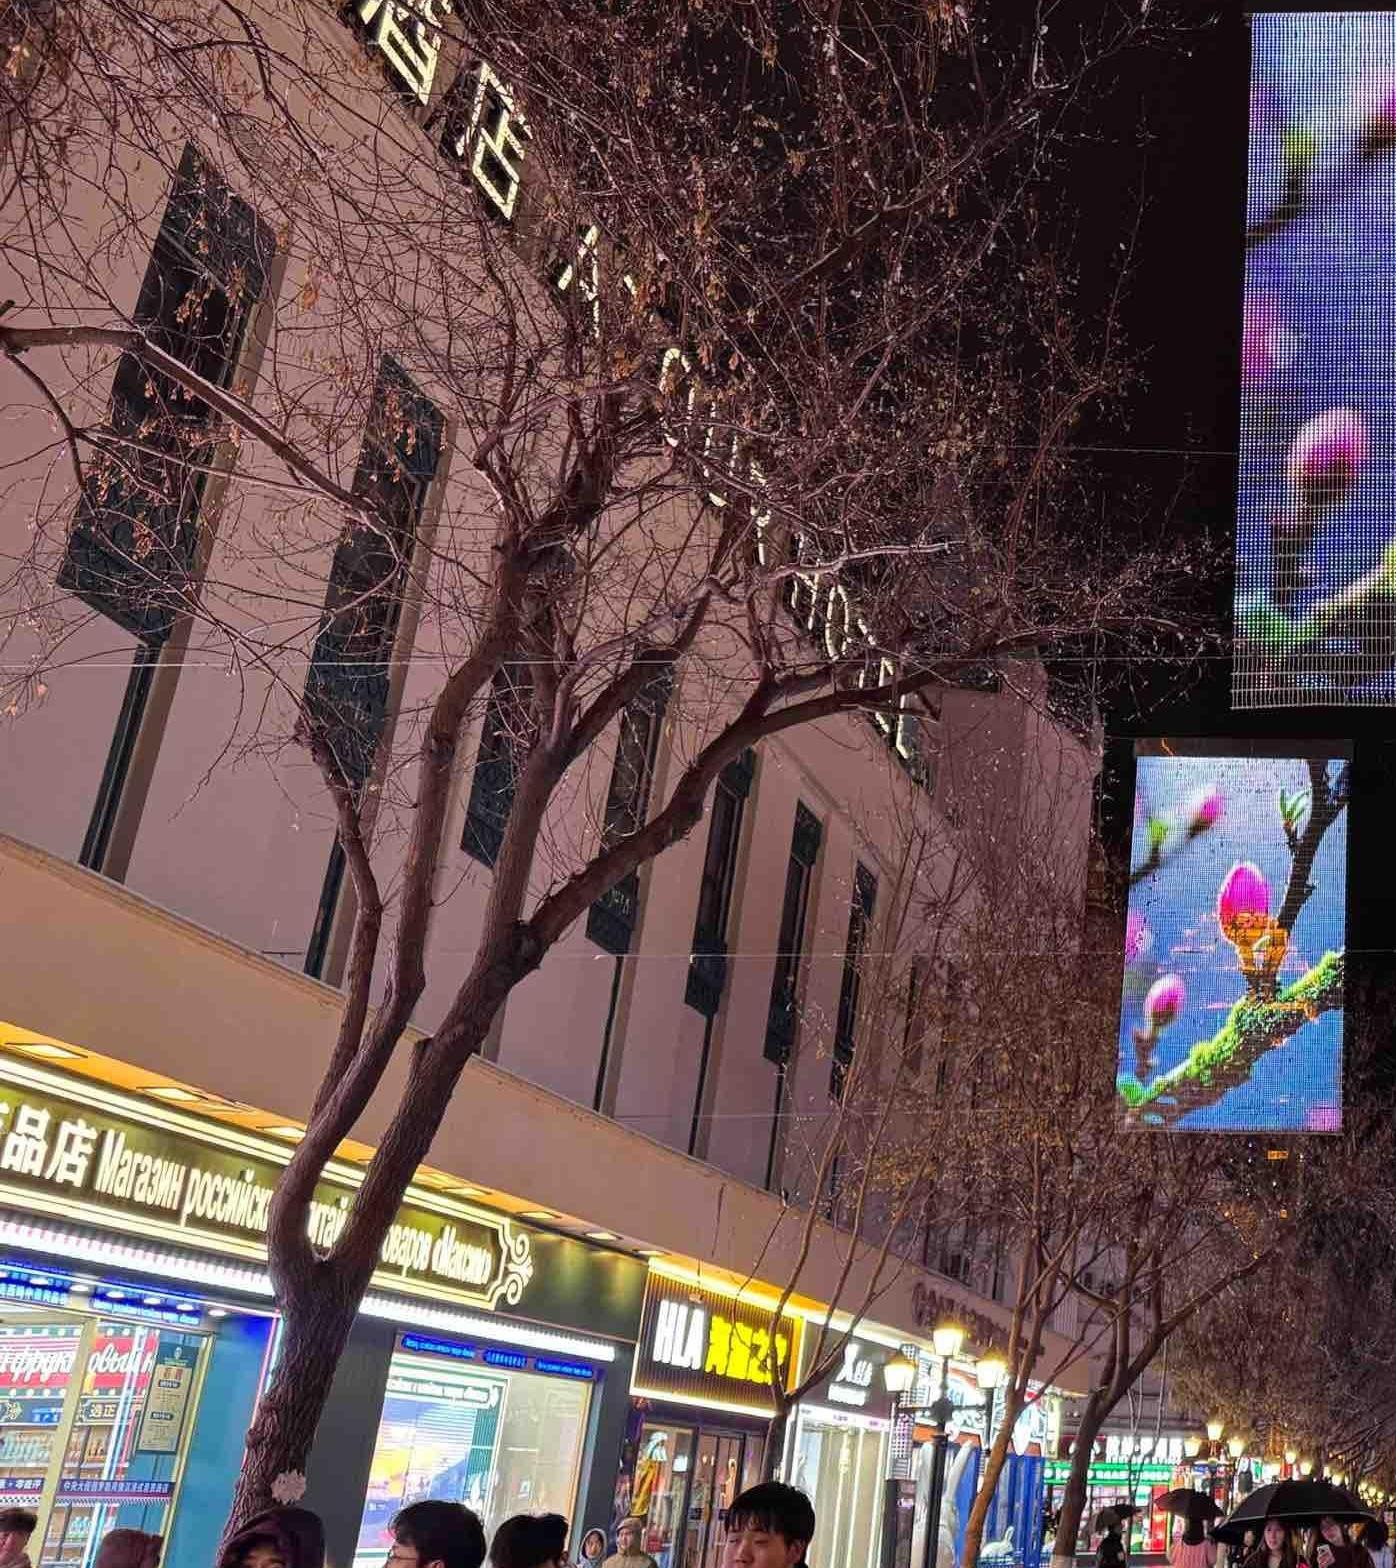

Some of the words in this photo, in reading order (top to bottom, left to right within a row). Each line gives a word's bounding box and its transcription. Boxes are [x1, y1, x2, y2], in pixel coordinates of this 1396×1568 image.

[0, 1103, 98, 1189] 品店
[95, 1128, 187, 1211] Магазин
[179, 1167, 275, 1233] российск
[653, 1299, 705, 1370] HLA
